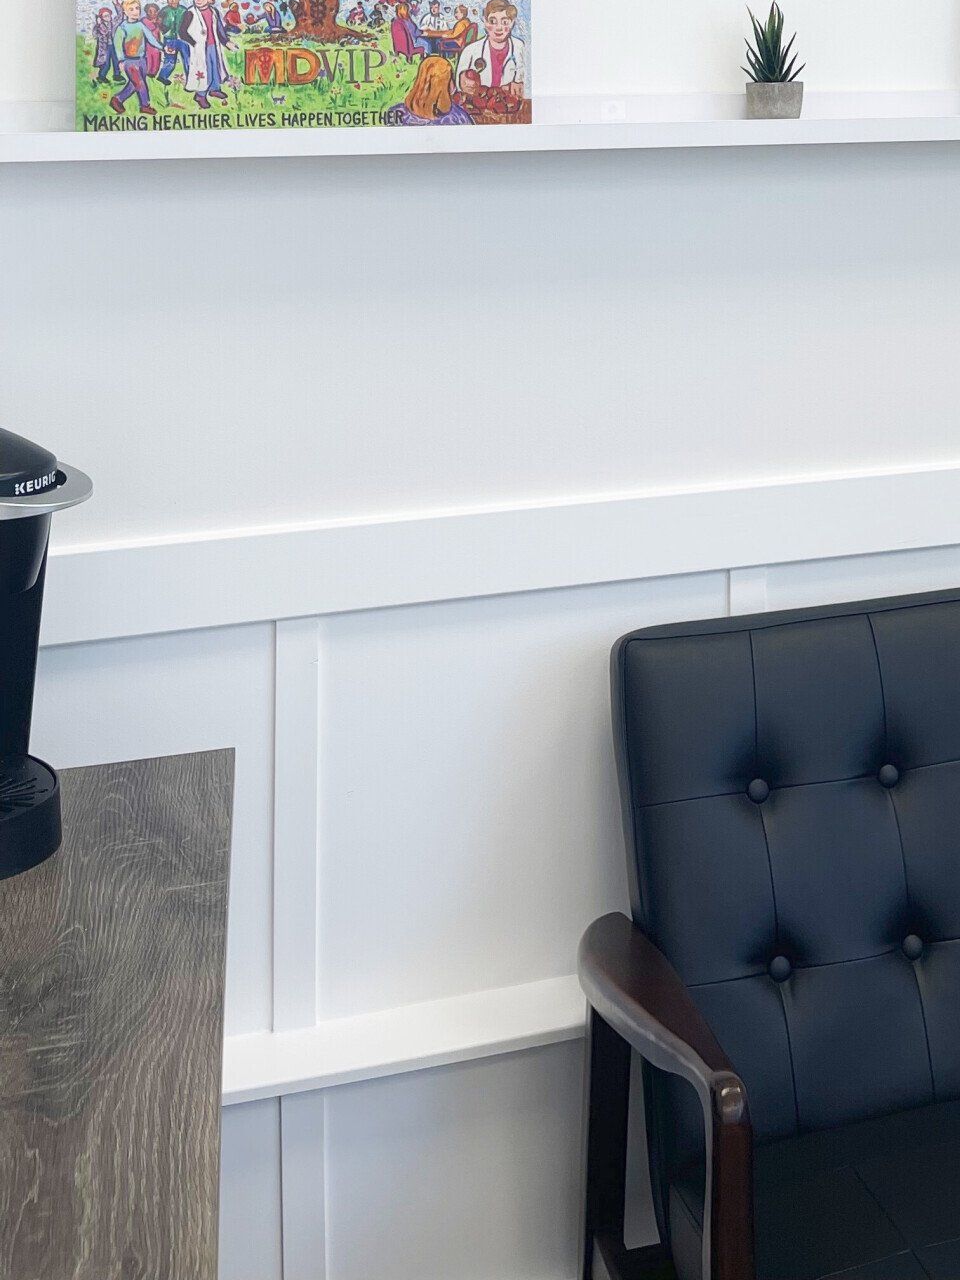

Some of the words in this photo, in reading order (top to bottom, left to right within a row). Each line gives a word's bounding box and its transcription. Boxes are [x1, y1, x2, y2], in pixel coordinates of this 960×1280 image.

[83, 114, 148, 132] MAKING
[152, 113, 232, 131] HEALTHIER
[236, 113, 276, 128] LIVES
[335, 110, 404, 126] TOGETHER
[14, 470, 57, 496] KEURIG
